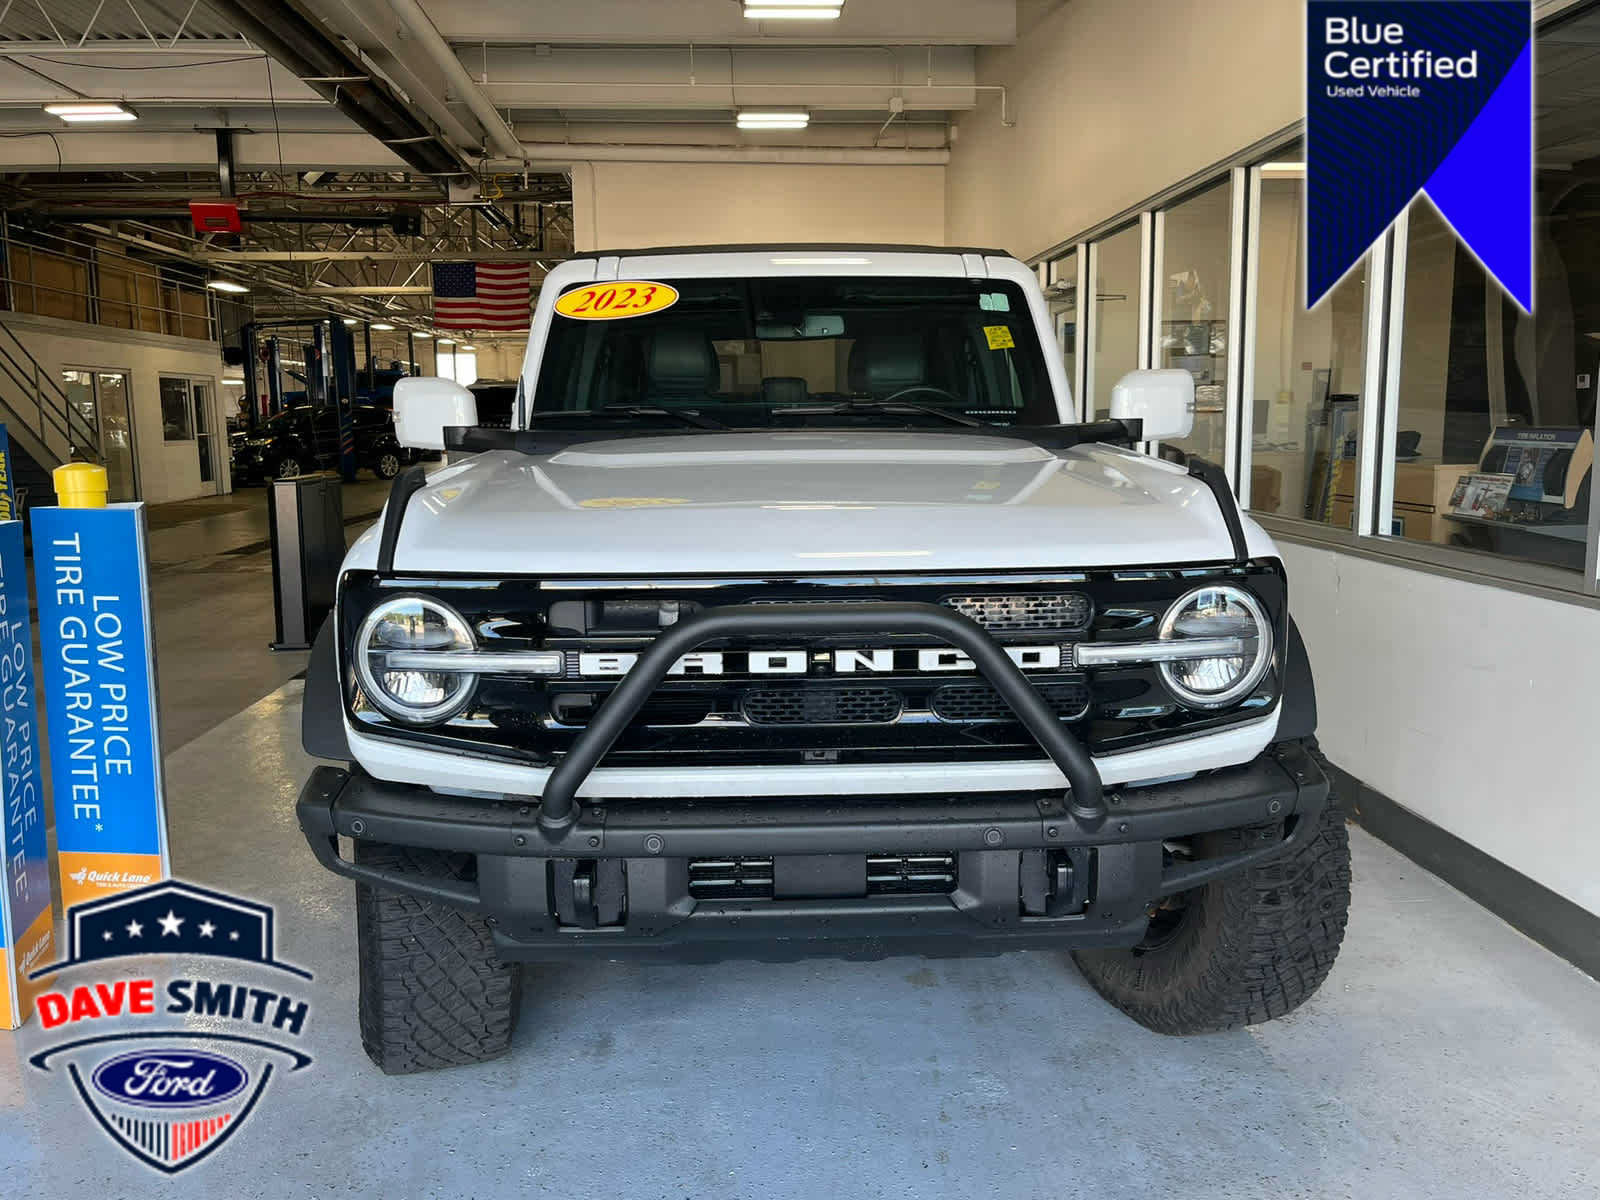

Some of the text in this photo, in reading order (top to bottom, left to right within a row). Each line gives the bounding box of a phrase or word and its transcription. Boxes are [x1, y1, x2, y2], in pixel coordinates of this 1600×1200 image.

[572, 287, 657, 312] 2023
[53, 532, 85, 606] TIRE
[93, 595, 132, 775] LOW PRICE
[579, 646, 1060, 675] BRONCO
[11, 621, 37, 831] LOW PRICE
[88, 870, 151, 883] Quick Lane
